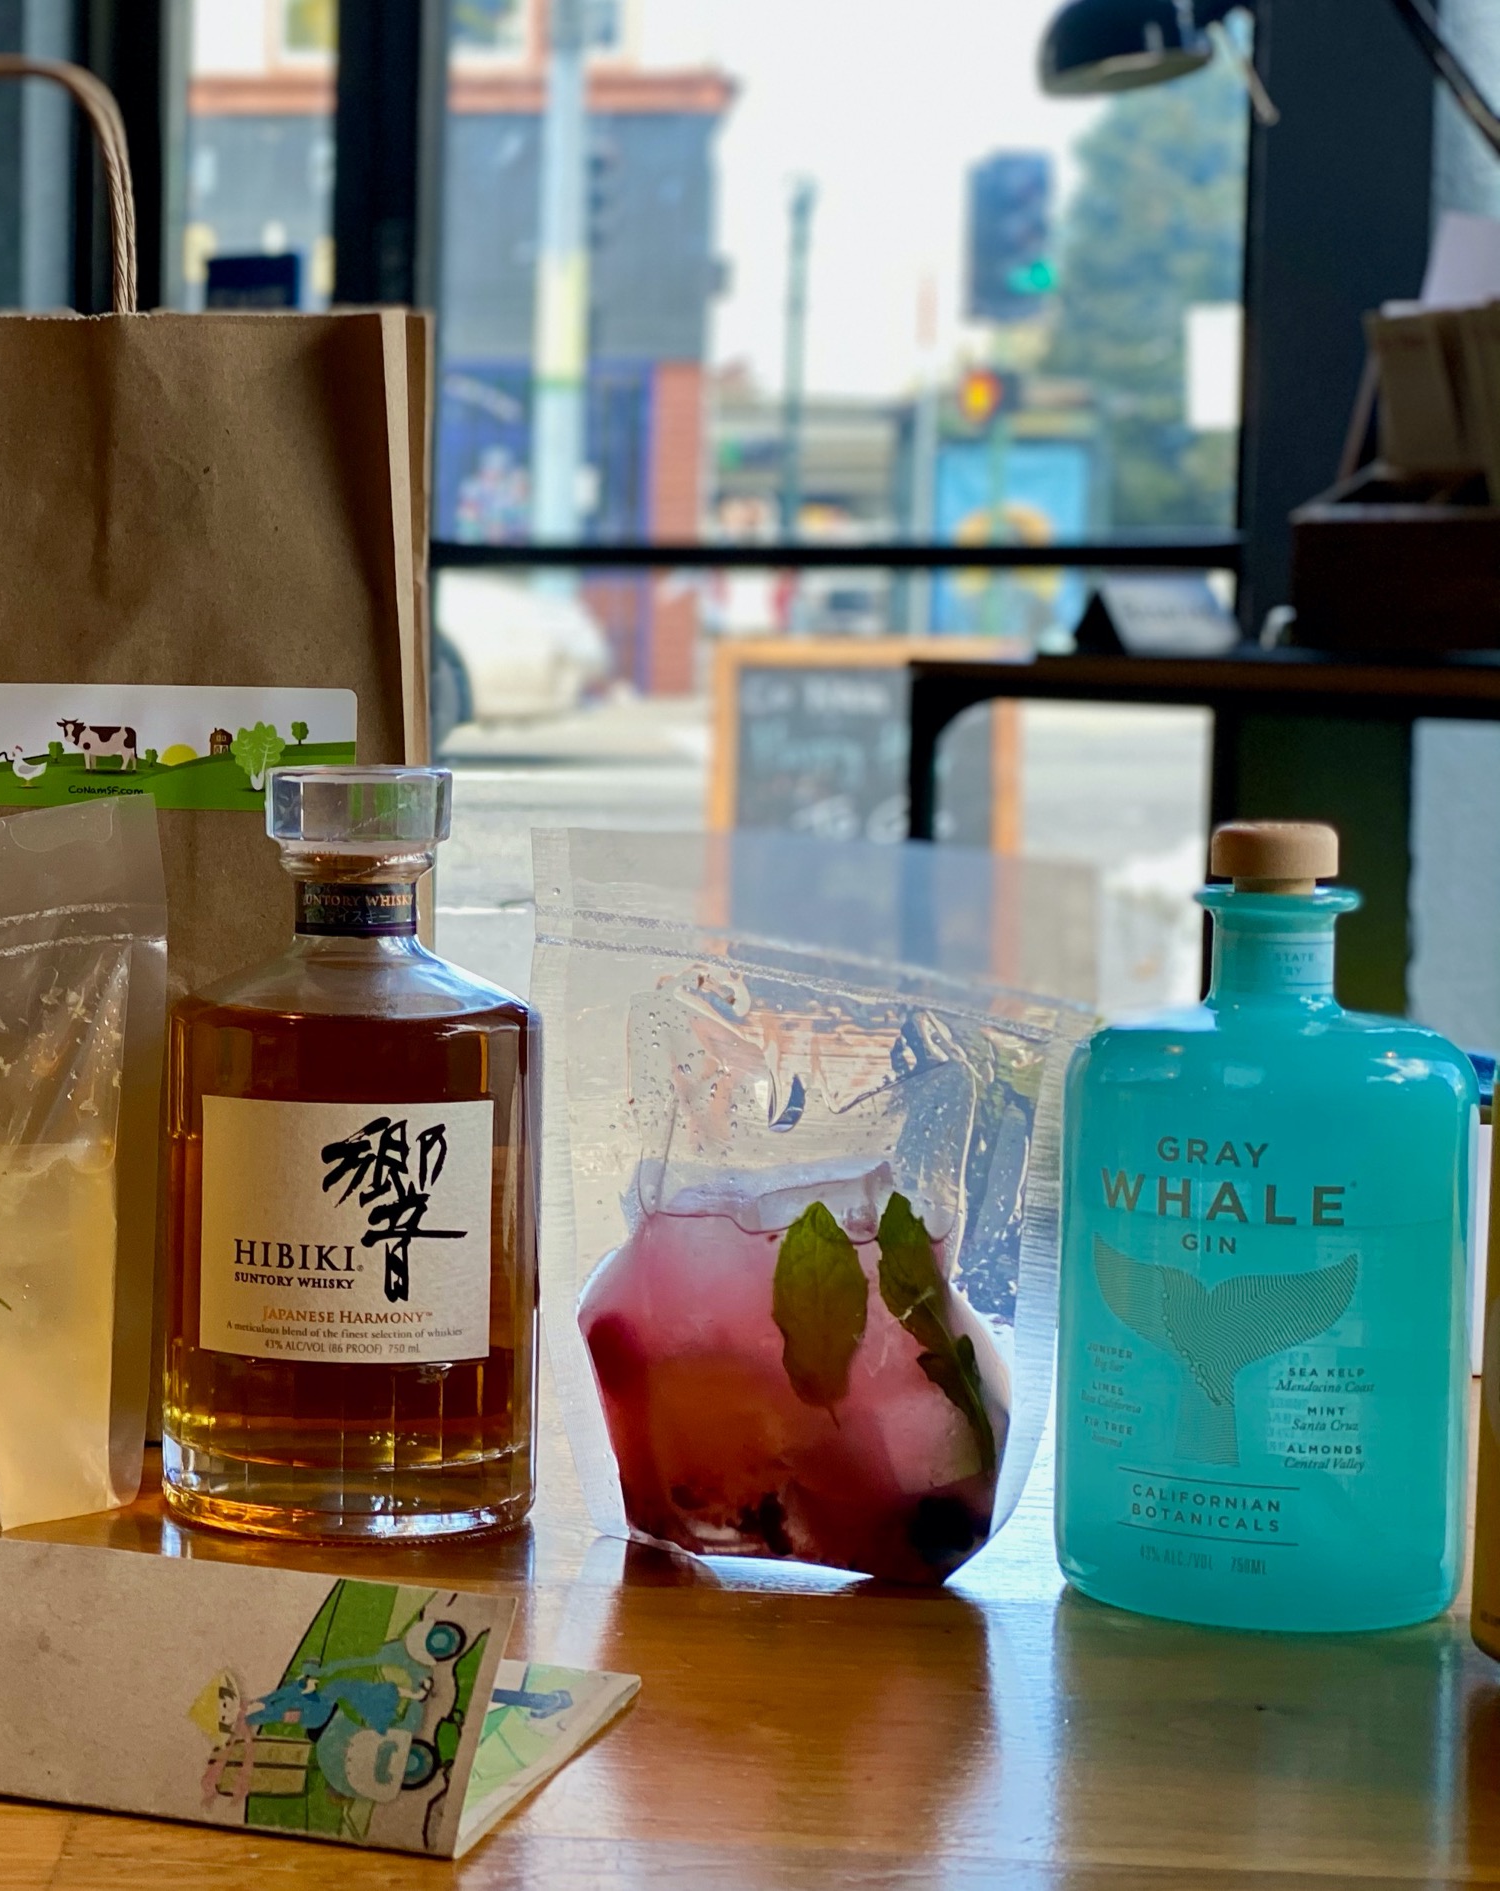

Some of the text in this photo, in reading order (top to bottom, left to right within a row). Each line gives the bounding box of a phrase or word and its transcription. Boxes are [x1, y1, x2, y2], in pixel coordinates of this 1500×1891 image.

[68, 785, 144, 795] CoNamSF.com
[365, 893, 413, 907] WHISKY
[1157, 1136, 1268, 1168] GRAY
[1101, 1167, 1345, 1226] WHALE
[1182, 1233, 1236, 1254] GIN
[234, 1271, 355, 1289] SUNTORY WHISKY
[262, 1306, 334, 1324] JAPANESE
[226, 1320, 463, 1339] A meticulous blend of the finest selection of whiskies
[264, 1340, 283, 1350] 43%
[285, 1341, 325, 1353] ALC/VOL
[328, 1342, 343, 1354] (86
[345, 1343, 383, 1355] PROOF)
[387, 1343, 405, 1354] 750
[1288, 1367, 1365, 1378] SEA KELP
[1275, 1379, 1375, 1393] Mendocino Coast
[1307, 1406, 1345, 1416] MINT
[1291, 1418, 1359, 1431] Santa Cruz
[1286, 1444, 1363, 1454] ALMONDS
[1284, 1456, 1365, 1473] Central Valley
[1132, 1483, 1281, 1513] CALIFORNIAN
[1131, 1502, 1280, 1532] BOTANICALS
